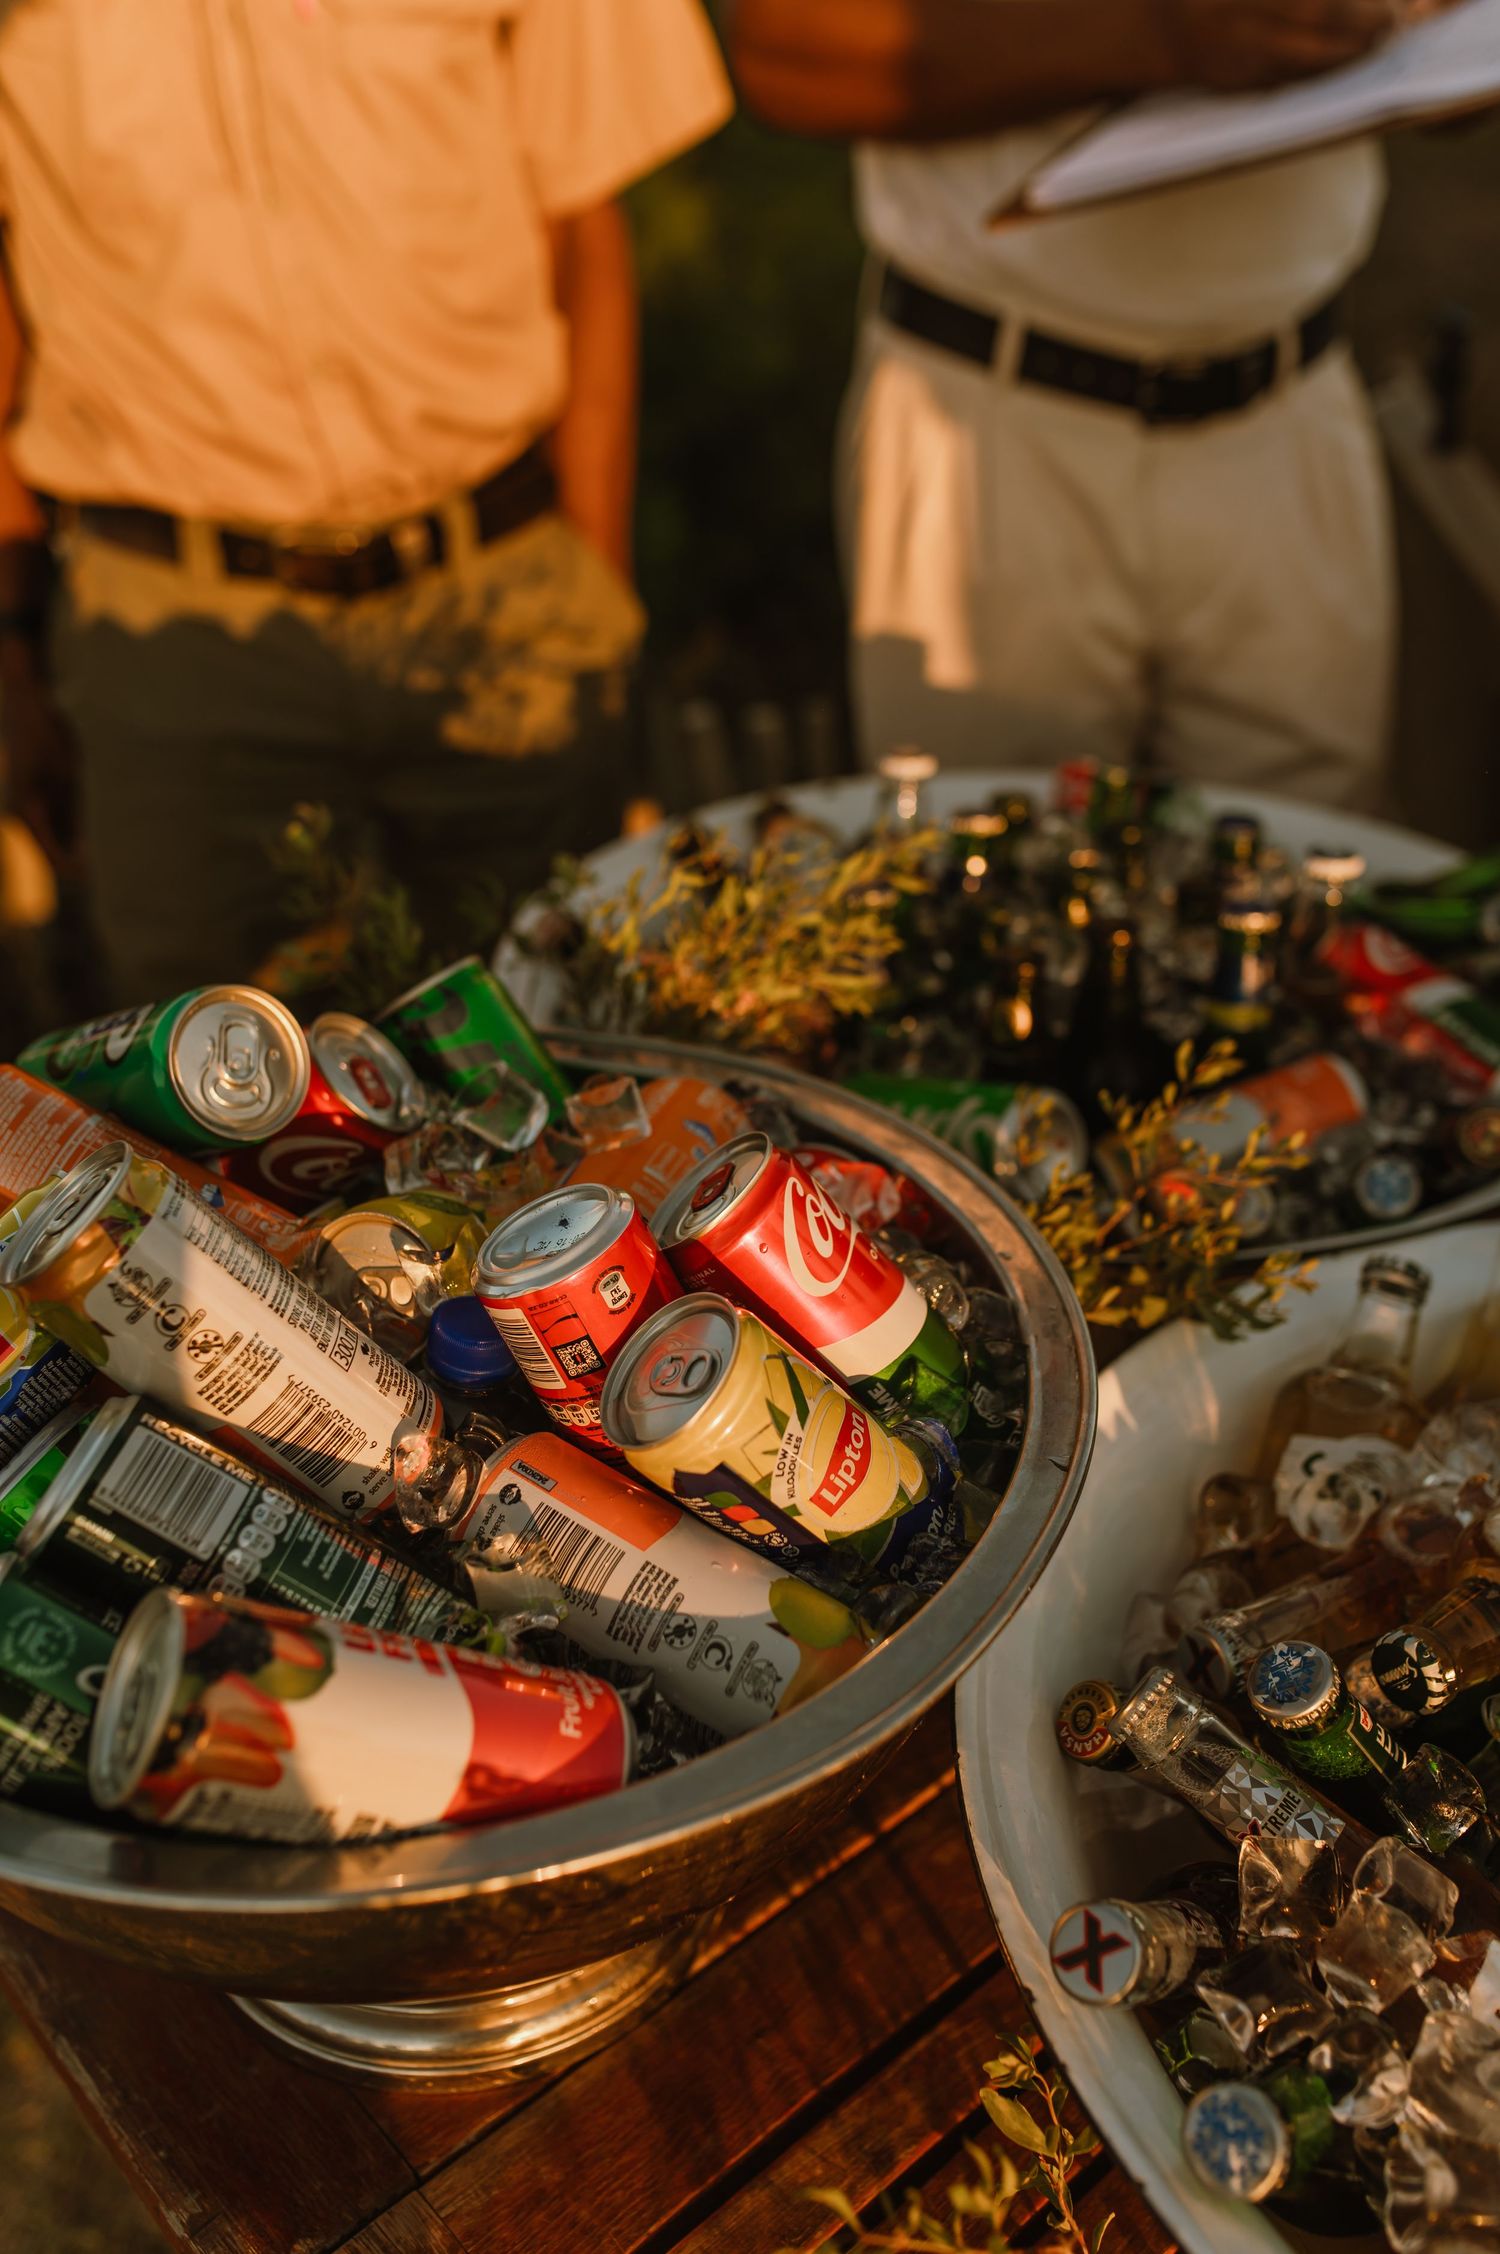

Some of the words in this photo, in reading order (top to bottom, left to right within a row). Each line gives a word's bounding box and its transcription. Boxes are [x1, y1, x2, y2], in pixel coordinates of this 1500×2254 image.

[609, 1290, 628, 1306] Energy
[333, 1336, 355, 1366] 300
[294, 1378, 332, 1412] 239377
[329, 1407, 368, 1442] 001240
[138, 1410, 225, 1468] RECYCLE
[775, 1449, 789, 1478] LOW
[785, 1433, 794, 1445] IN
[820, 1412, 865, 1506] Lipton
[358, 1461, 382, 1486] shake
[366, 1473, 387, 1496] serve
[480, 1503, 498, 1526] serve
[488, 1513, 506, 1536] shake
[1060, 1726, 1104, 1753] HANSA
